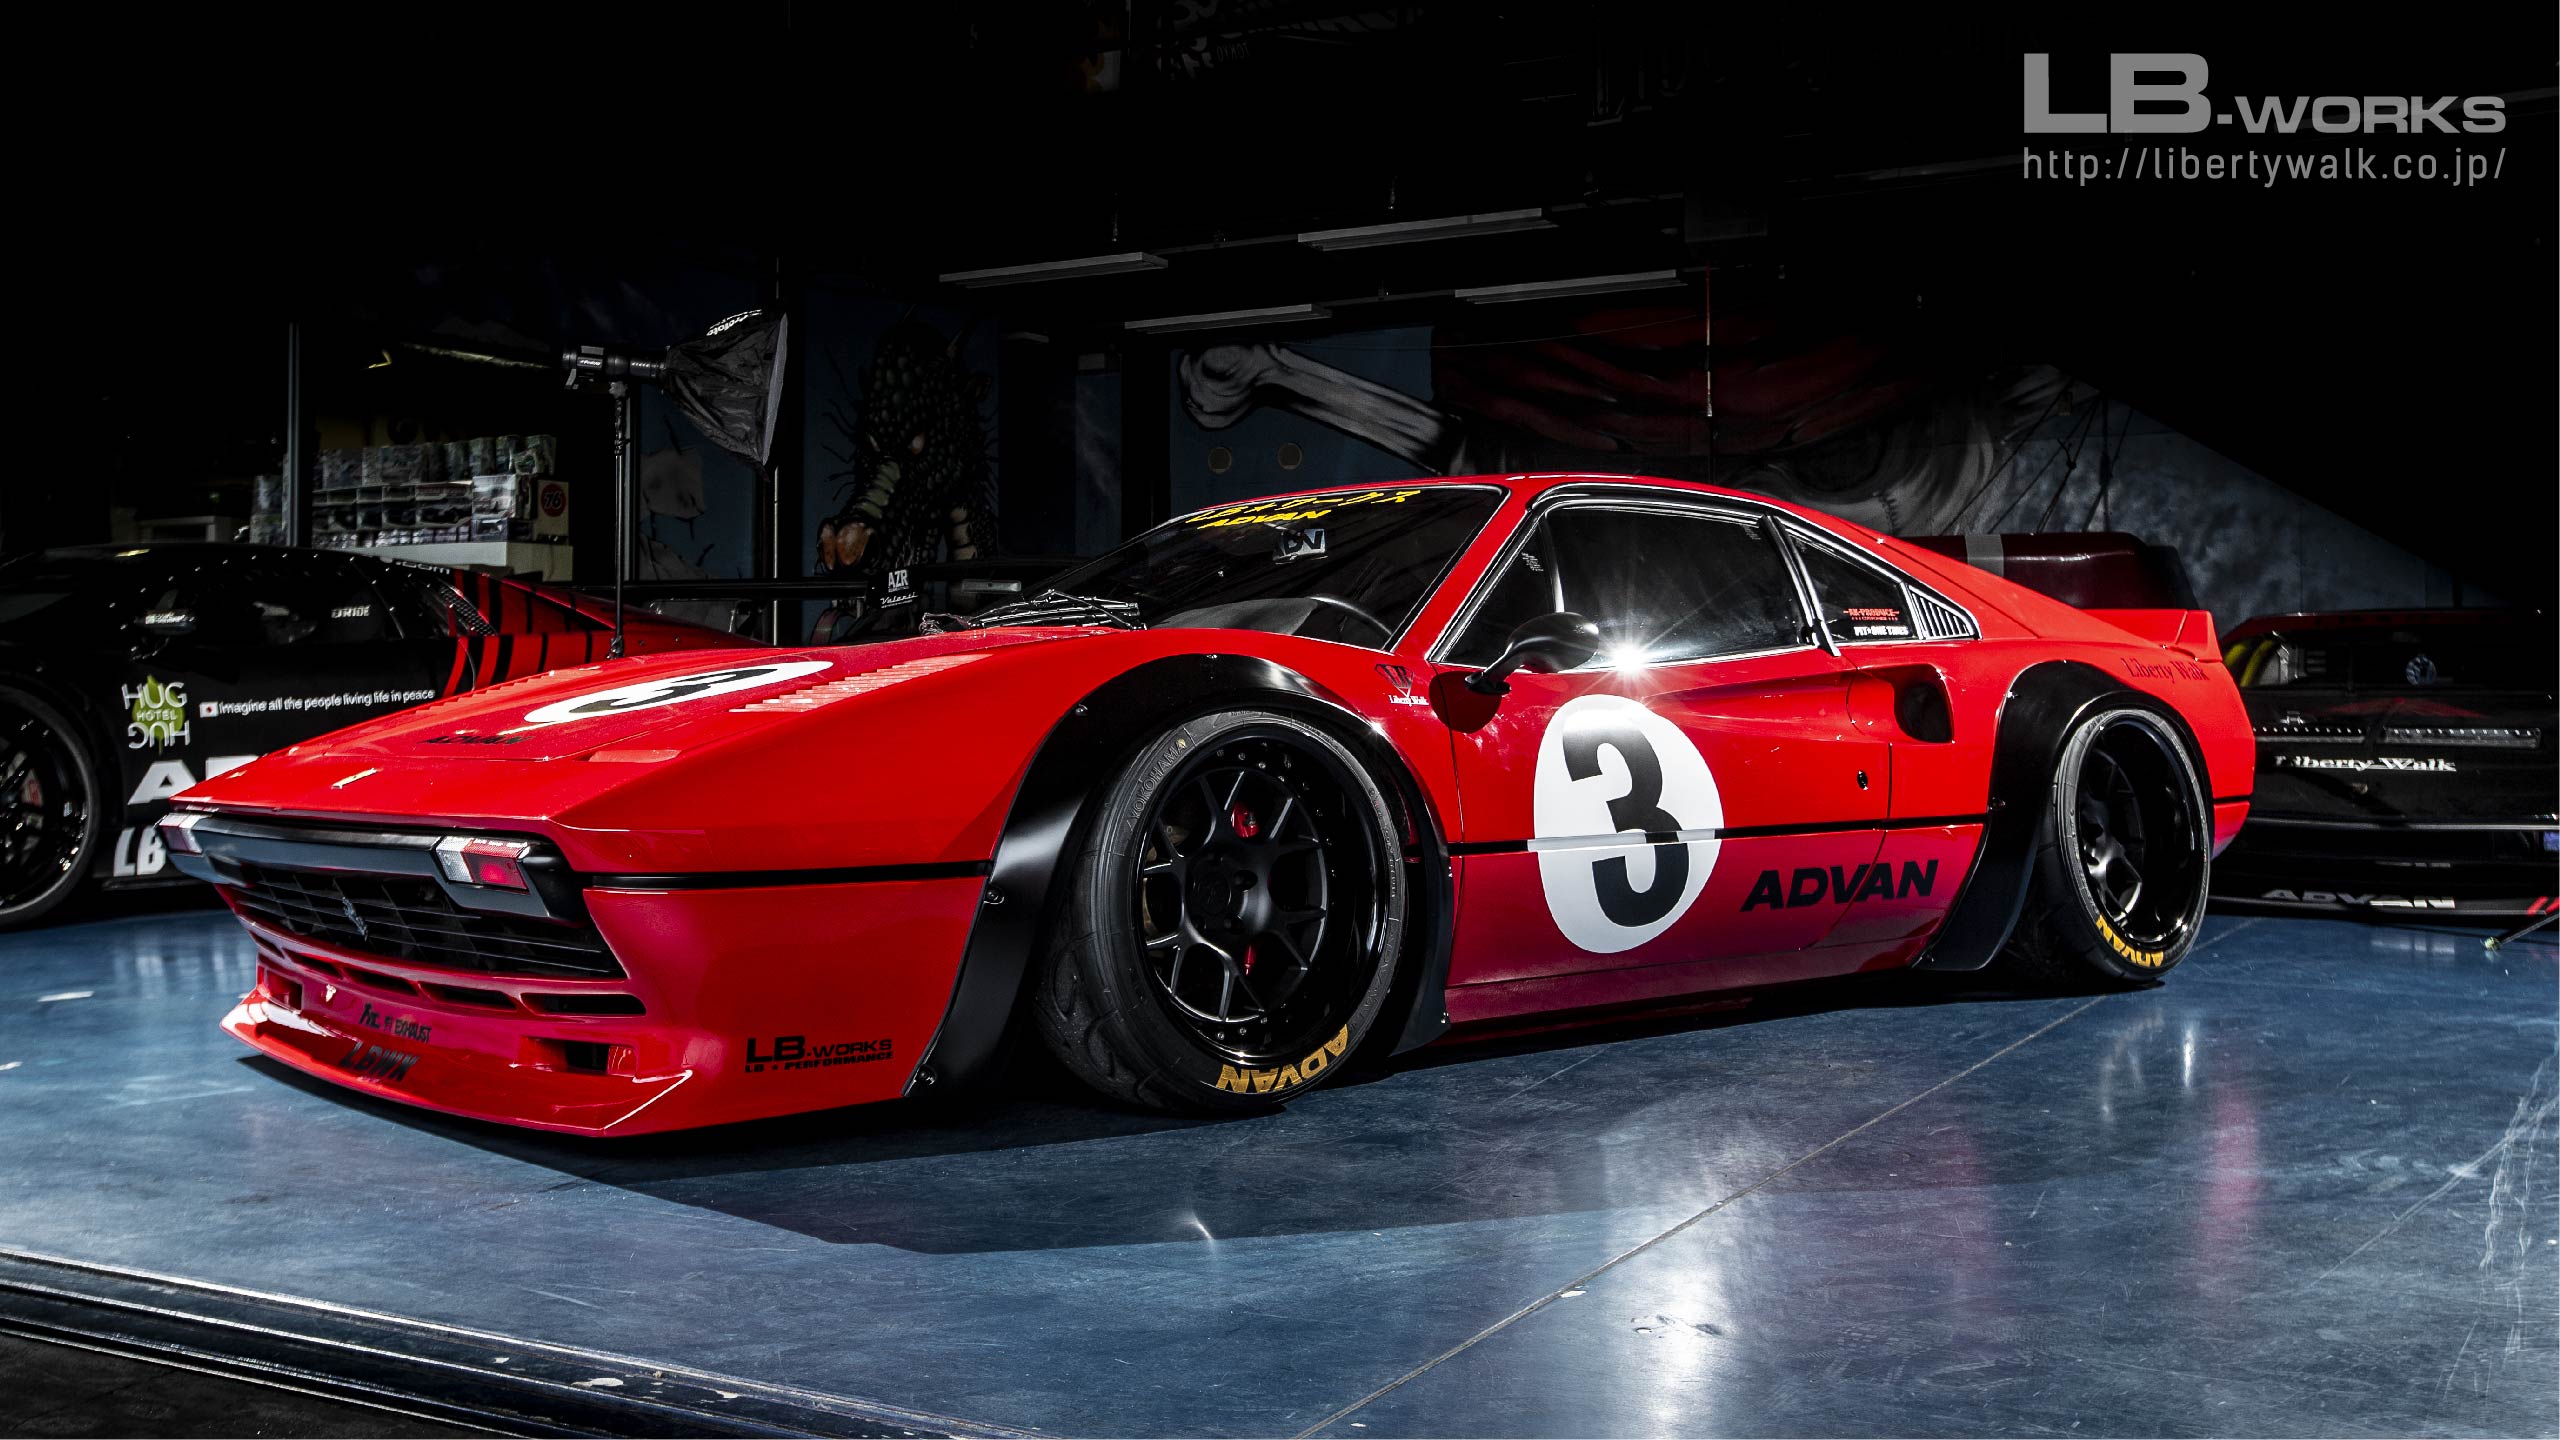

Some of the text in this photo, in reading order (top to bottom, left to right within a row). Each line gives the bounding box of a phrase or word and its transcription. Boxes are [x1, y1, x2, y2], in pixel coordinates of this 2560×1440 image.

[1196, 509, 1332, 530] ADVAN
[2119, 657, 2211, 684] Liberty Walk
[121, 681, 188, 710] HUG
[219, 687, 435, 716] Imagine all the people living life in peace
[567, 668, 779, 714] 3
[136, 709, 178, 721] HOTEL
[2377, 757, 2457, 772] Walk
[1562, 707, 1690, 928] 3
[1739, 860, 1938, 913] ADVAN
[2095, 914, 2164, 968] ADVAN
[746, 1035, 893, 1064] LB-WORKS
[784, 1051, 894, 1071] PERFORMANCE
[1215, 1023, 1349, 1094] ADVAN
